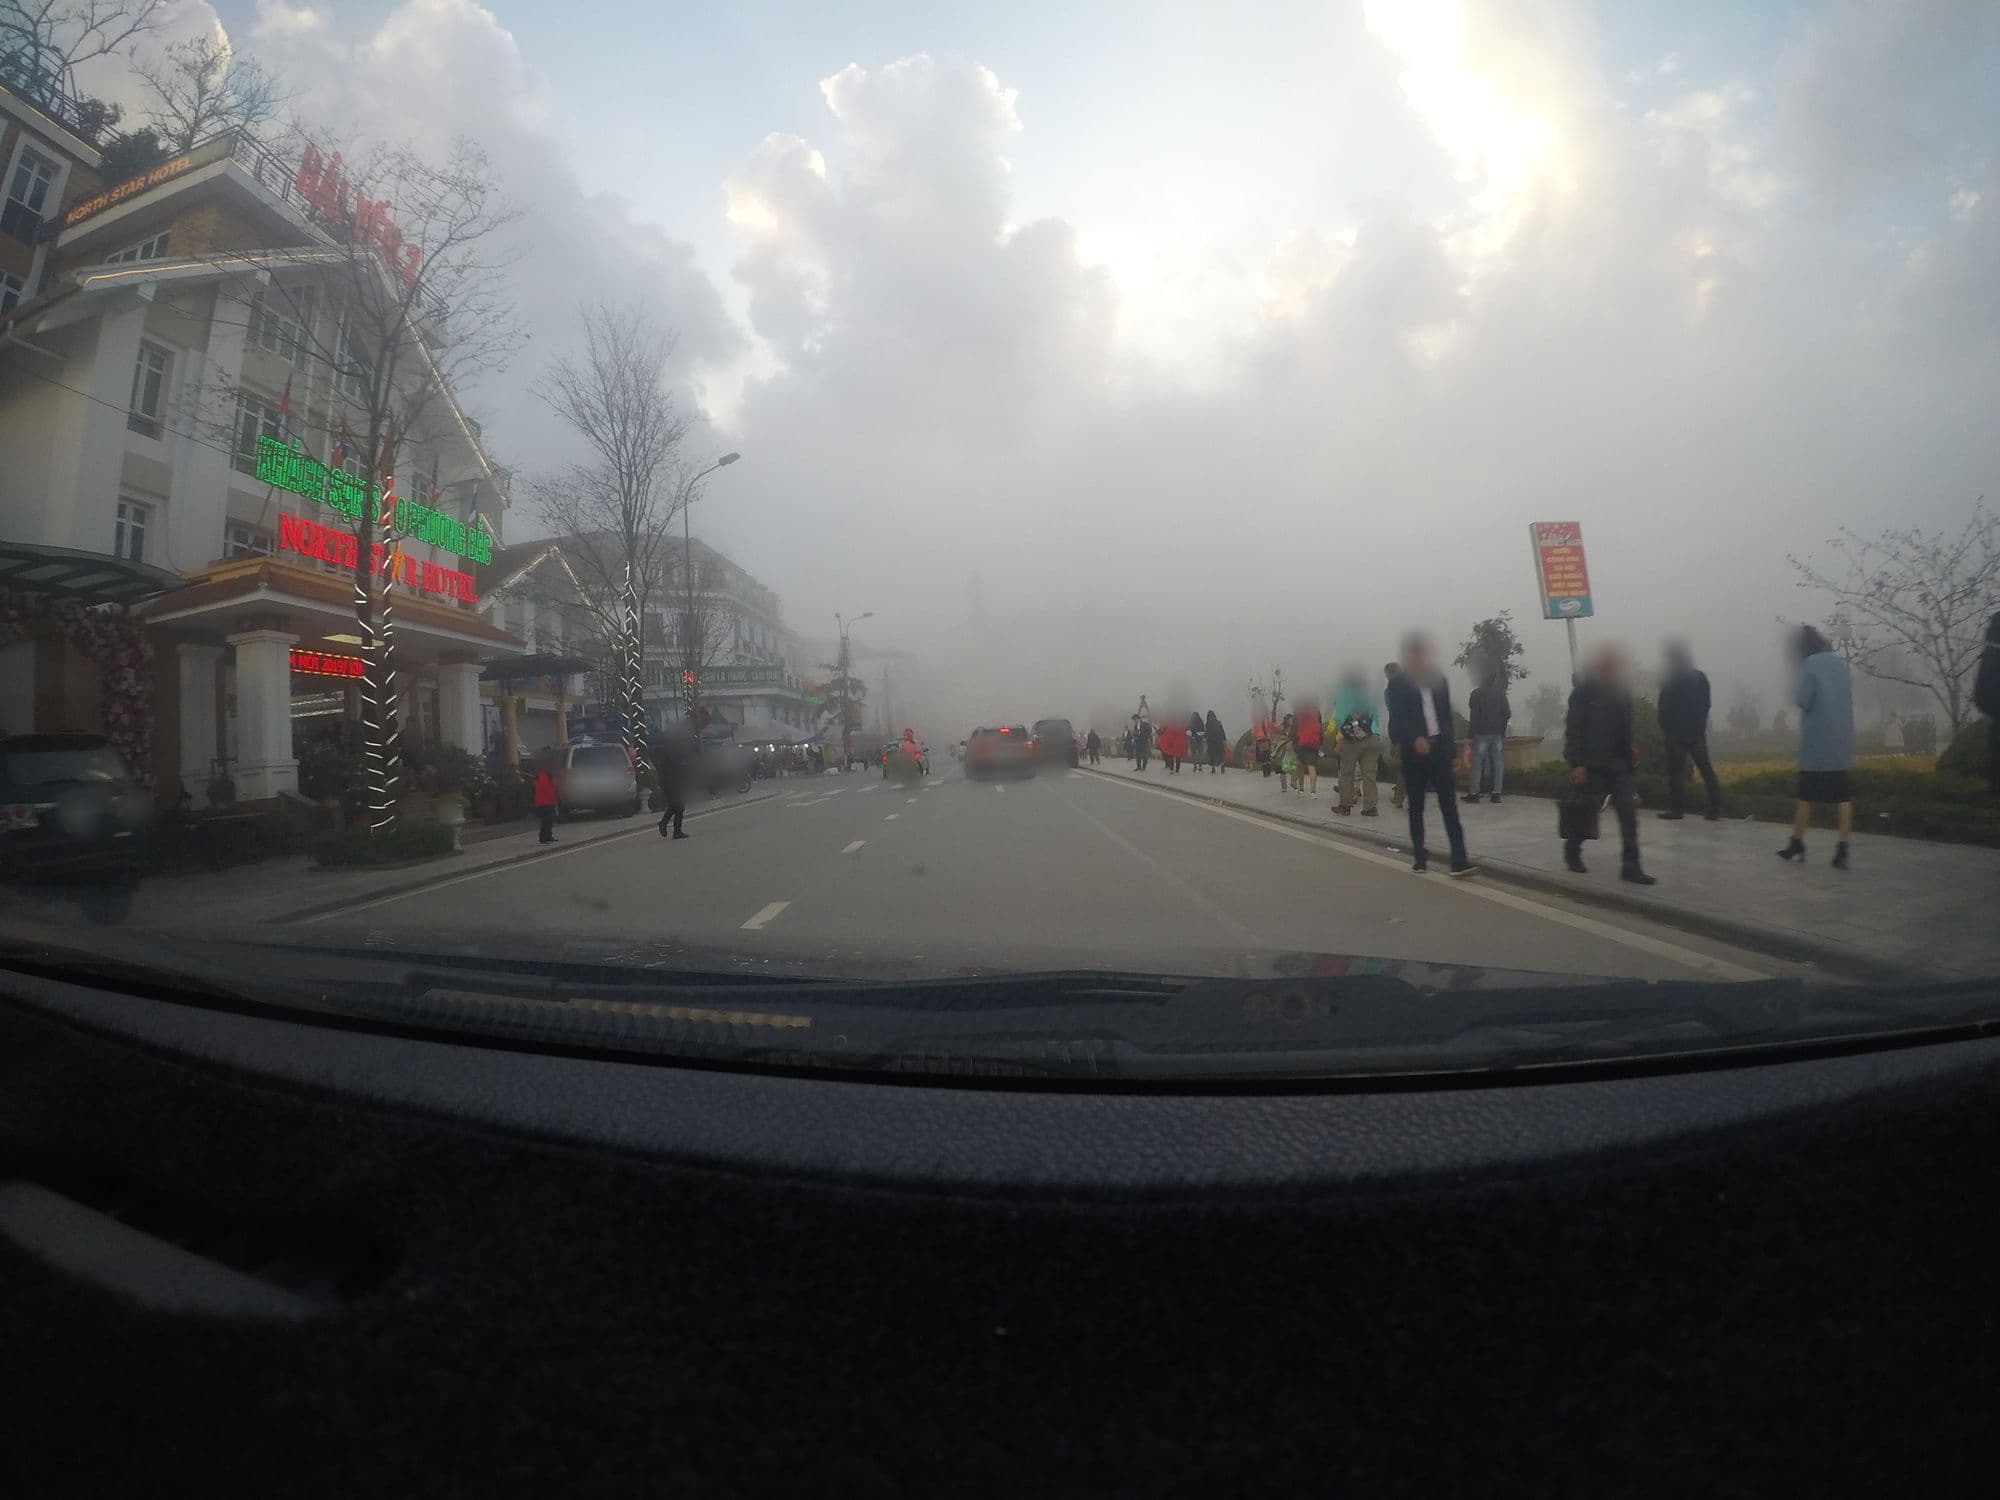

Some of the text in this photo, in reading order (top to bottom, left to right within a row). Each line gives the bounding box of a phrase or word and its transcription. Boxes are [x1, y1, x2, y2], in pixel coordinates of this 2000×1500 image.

[67, 156, 191, 223] NORTH STAR HOTEL
[256, 434, 325, 503] KHÁCH
[467, 514, 493, 566] BẮC
[279, 512, 359, 570] NORTH
[422, 560, 478, 604] HOTEL
